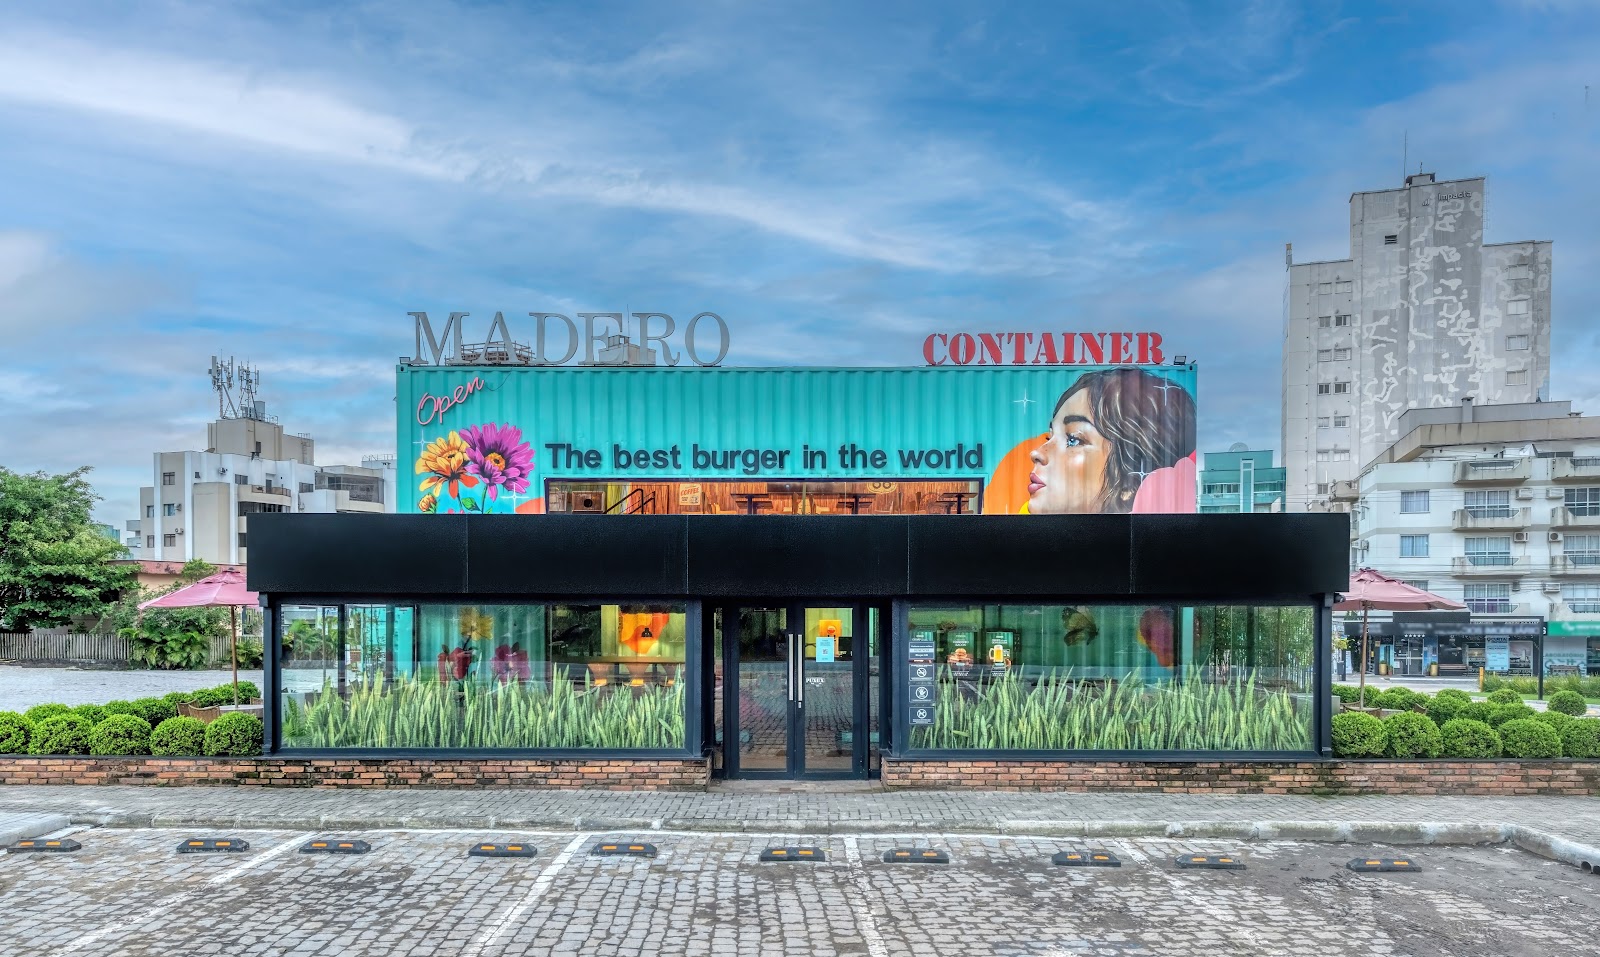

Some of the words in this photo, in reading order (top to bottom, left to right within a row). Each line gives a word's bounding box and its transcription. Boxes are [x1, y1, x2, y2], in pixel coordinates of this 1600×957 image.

[1438, 191, 1472, 201] Impacta
[407, 311, 731, 366] MADERO
[923, 332, 1165, 365] CONTAINER
[416, 376, 485, 425] Open
[545, 443, 602, 469] The
[613, 443, 681, 469] best
[692, 443, 790, 475] burger
[803, 444, 826, 469] in
[838, 444, 887, 469] the
[898, 443, 984, 469] world
[681, 487, 699, 496] COFFEE
